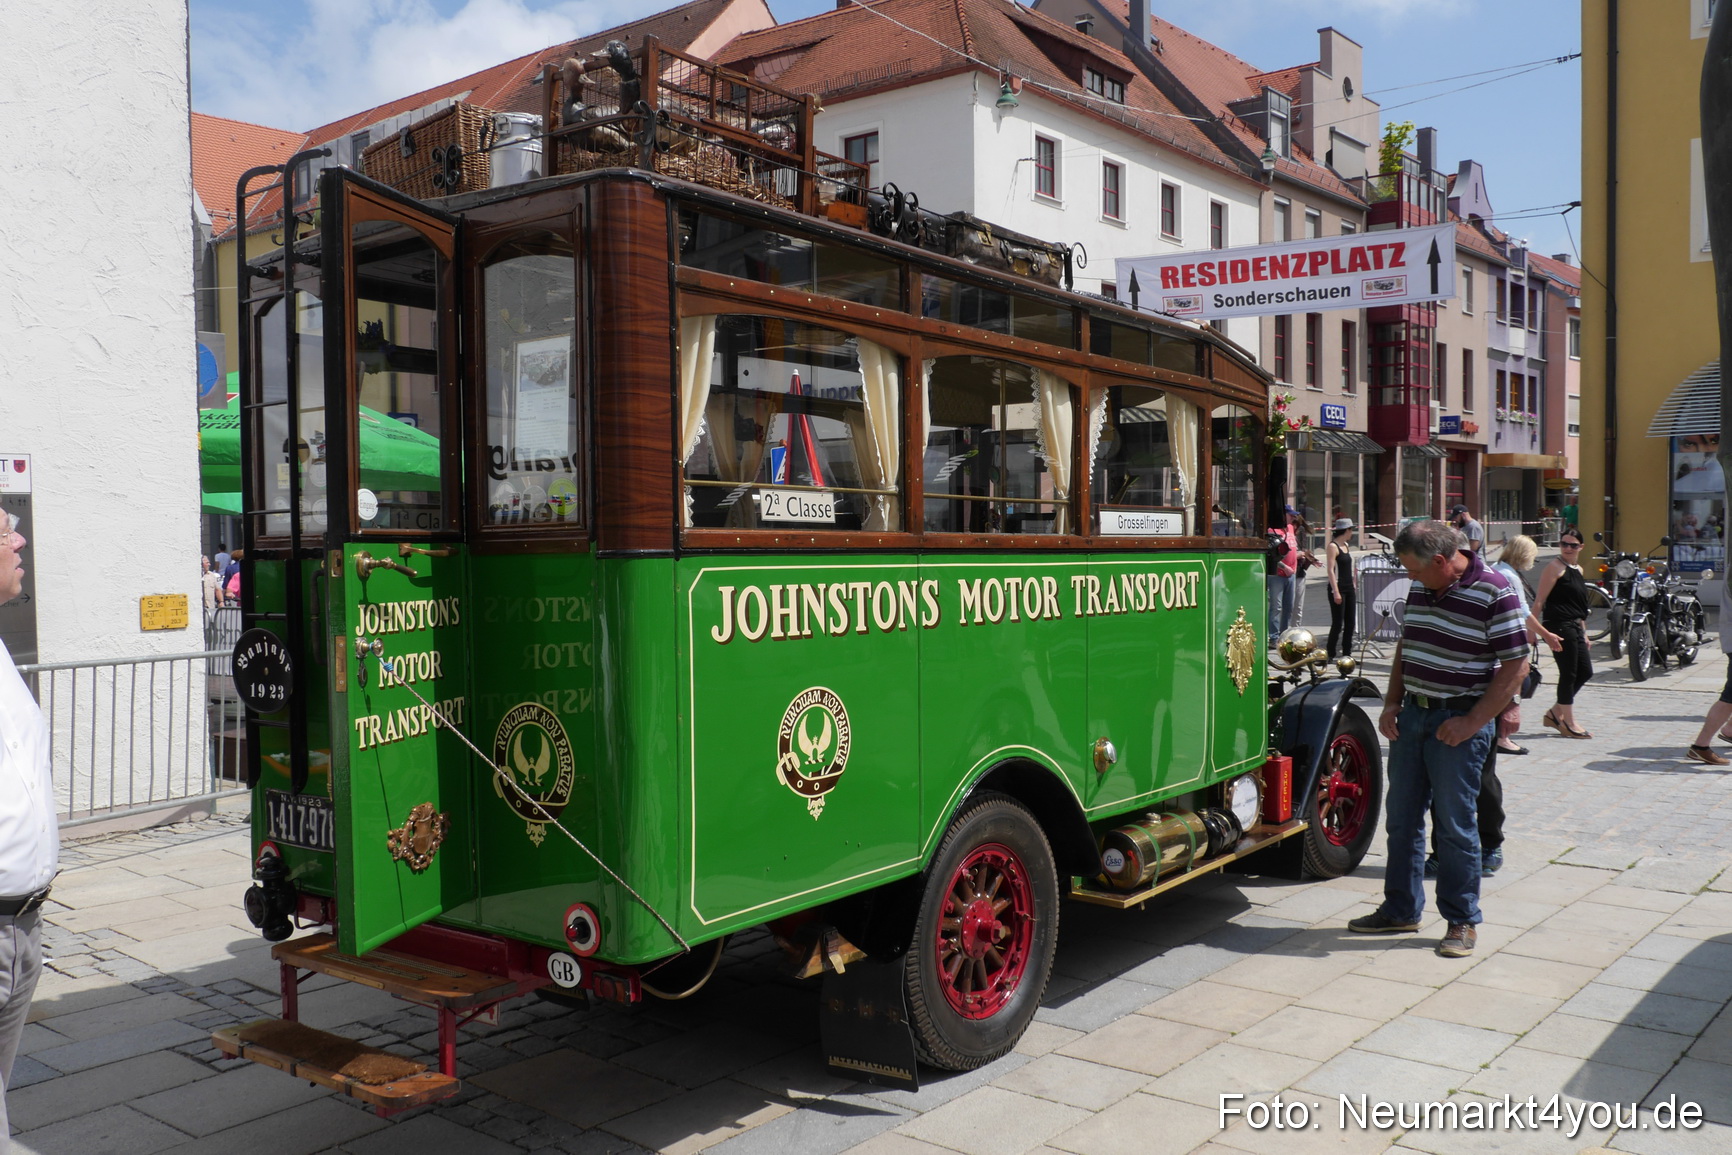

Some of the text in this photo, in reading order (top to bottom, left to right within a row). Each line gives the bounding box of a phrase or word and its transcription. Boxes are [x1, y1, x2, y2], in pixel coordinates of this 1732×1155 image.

[1160, 241, 1406, 289] RESIDENZPLATZ
[1214, 285, 1351, 308] Sonderschauen
[1326, 406, 1345, 420] CECIL
[786, 496, 832, 518] Classe
[1117, 514, 1169, 530] Grosselfingen
[355, 595, 461, 637] JOHNSTON'S
[711, 571, 1200, 644] JOHNSTON'S MOTOR TRANSPORT
[237, 636, 291, 673] Baujahr
[378, 650, 444, 689] MOTOR
[250, 682, 285, 700] 1923
[354, 696, 465, 750] TRANSPORT
[822, 692, 841, 715] NON
[835, 711, 849, 767] PARATUS
[540, 711, 562, 738] NON
[556, 738, 572, 798] PARATUS
[1105, 855, 1122, 866] Esso
[551, 958, 575, 982] GB
